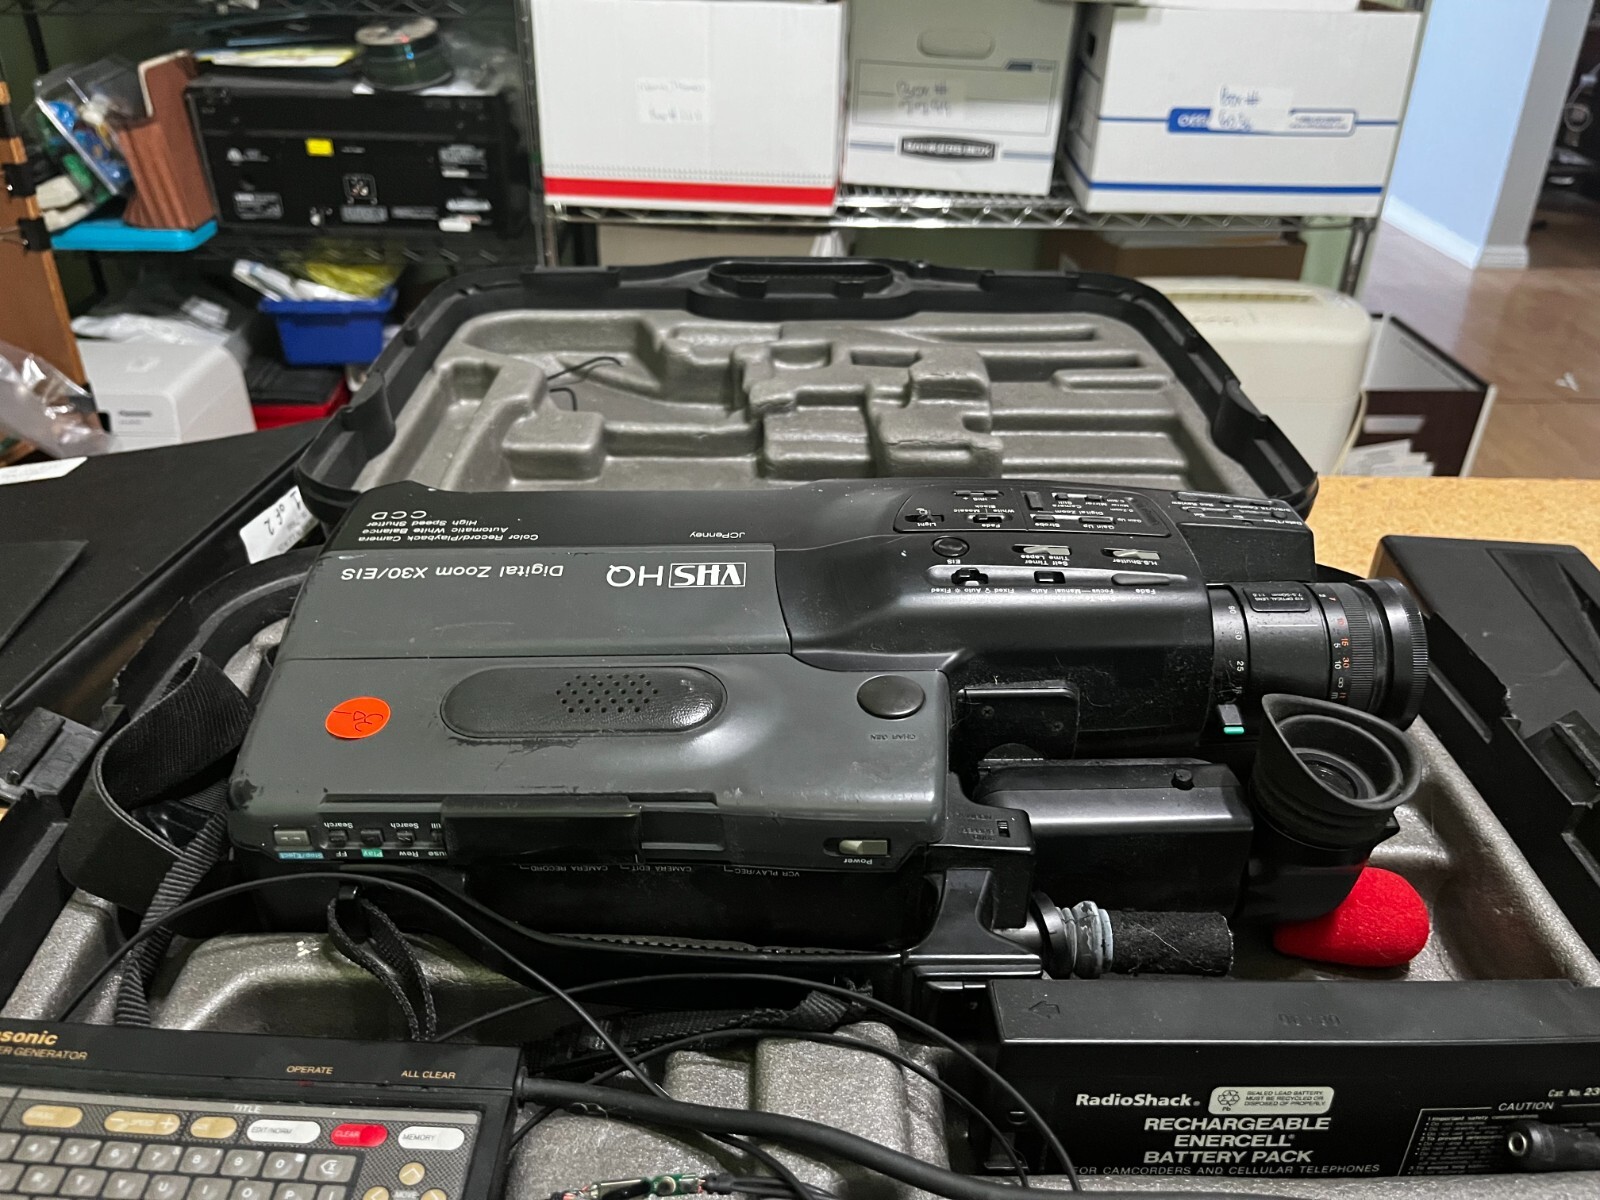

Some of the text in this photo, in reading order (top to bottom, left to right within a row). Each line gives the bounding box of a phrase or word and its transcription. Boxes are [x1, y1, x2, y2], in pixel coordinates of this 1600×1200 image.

[366, 519, 478, 528] High Speed Shutter
[362, 526, 509, 536] Automatic White Balance
[689, 531, 745, 539] JCPenney
[358, 533, 539, 543] Color Record/Playback Camera
[341, 563, 564, 580] Digital Zoom X30/EIS
[606, 564, 742, 587] VHS HQ
[1228, 605, 1236, 614] 90
[1236, 661, 1244, 672] 25
[1342, 657, 1349, 668] 30
[362, 848, 383, 858] Play
[399, 850, 419, 858] Rew
[427, 850, 447, 858] use
[843, 857, 874, 866] Power
[570, 864, 608, 872] CAMERA
[655, 865, 692, 873] CAMERA
[782, 870, 800, 878] VCR
[0, 1030, 58, 1046] sonic
[14, 1047, 88, 1060] GENERATOR
[286, 1065, 334, 1075] OPERATE
[401, 1070, 456, 1080] ALL CLEAR
[1076, 1093, 1193, 1107] RadioShack
[233, 1104, 263, 1114] TITLE
[1498, 1101, 1555, 1111] CAUTION
[1144, 1117, 1332, 1131] RECHARGEABLE
[335, 1130, 361, 1138] CLEAR
[402, 1133, 437, 1141] MEMORY
[28, 1143, 38, 1152] 4
[69, 1145, 79, 1155] 5
[110, 1148, 120, 1158] 6
[152, 1151, 161, 1161] 7
[1143, 1150, 1314, 1164] BATTERY PACK
[192, 1154, 202, 1164] 8
[233, 1156, 244, 1166] 9
[1102, 1166, 1192, 1175] CAMCORDERS
[1195, 1166, 1224, 1175] AND
[1229, 1165, 1294, 1175] CELLULAR
[1299, 1164, 1381, 1174] TELEPHONES
[157, 1182, 168, 1191] U
[284, 1190, 295, 1200] P
